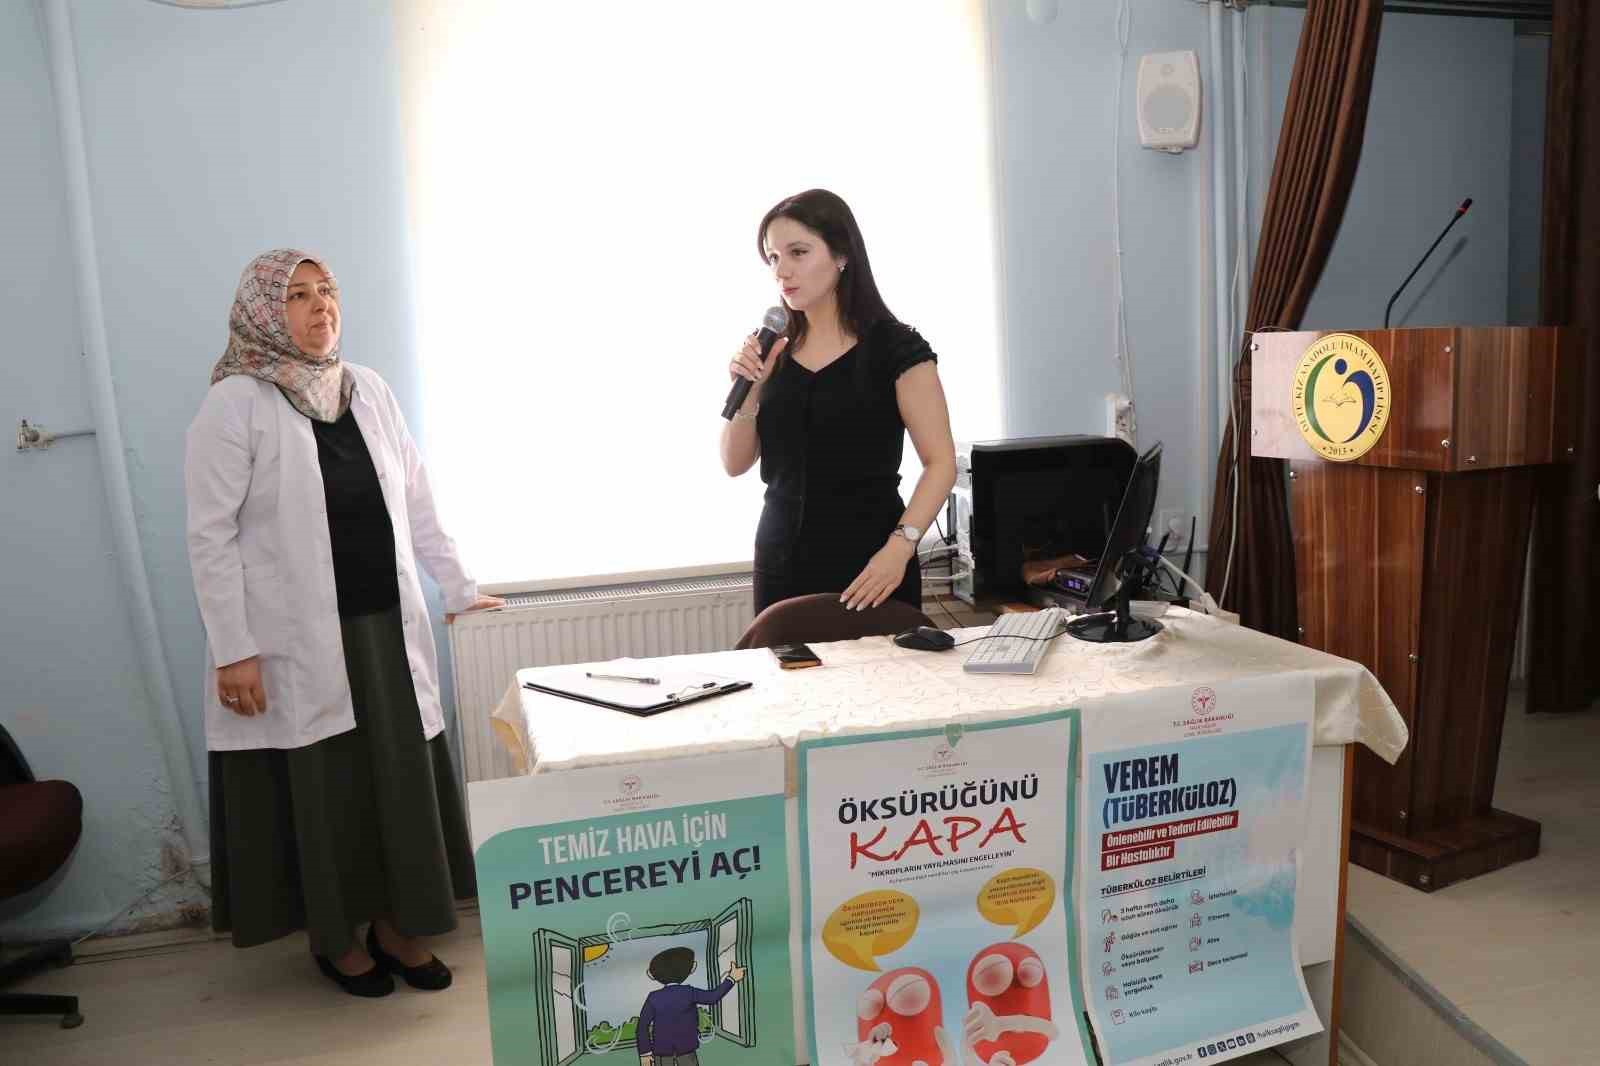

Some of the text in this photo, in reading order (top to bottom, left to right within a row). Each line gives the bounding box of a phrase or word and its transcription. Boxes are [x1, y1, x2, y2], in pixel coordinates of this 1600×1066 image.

[1103, 753, 1179, 793] VEREM
[838, 773, 1039, 824] ÖKSÜRÜĞÜNÜ
[1103, 778, 1237, 828] (TÜBERKÜLOZ)
[538, 810, 727, 865] TEMİZ HAVA İÇİN
[850, 807, 1027, 869] KAPA
[1107, 814, 1235, 848] Önlenebilir ve Tedavi Edilebilir
[509, 845, 761, 910] PENCEREYİ AÇ!
[1101, 865, 1207, 895] TÜBERKÜLOZ BELİRTİLERİ
[1106, 853, 1119, 867] Bir
[1125, 904, 1143, 913] hafta
